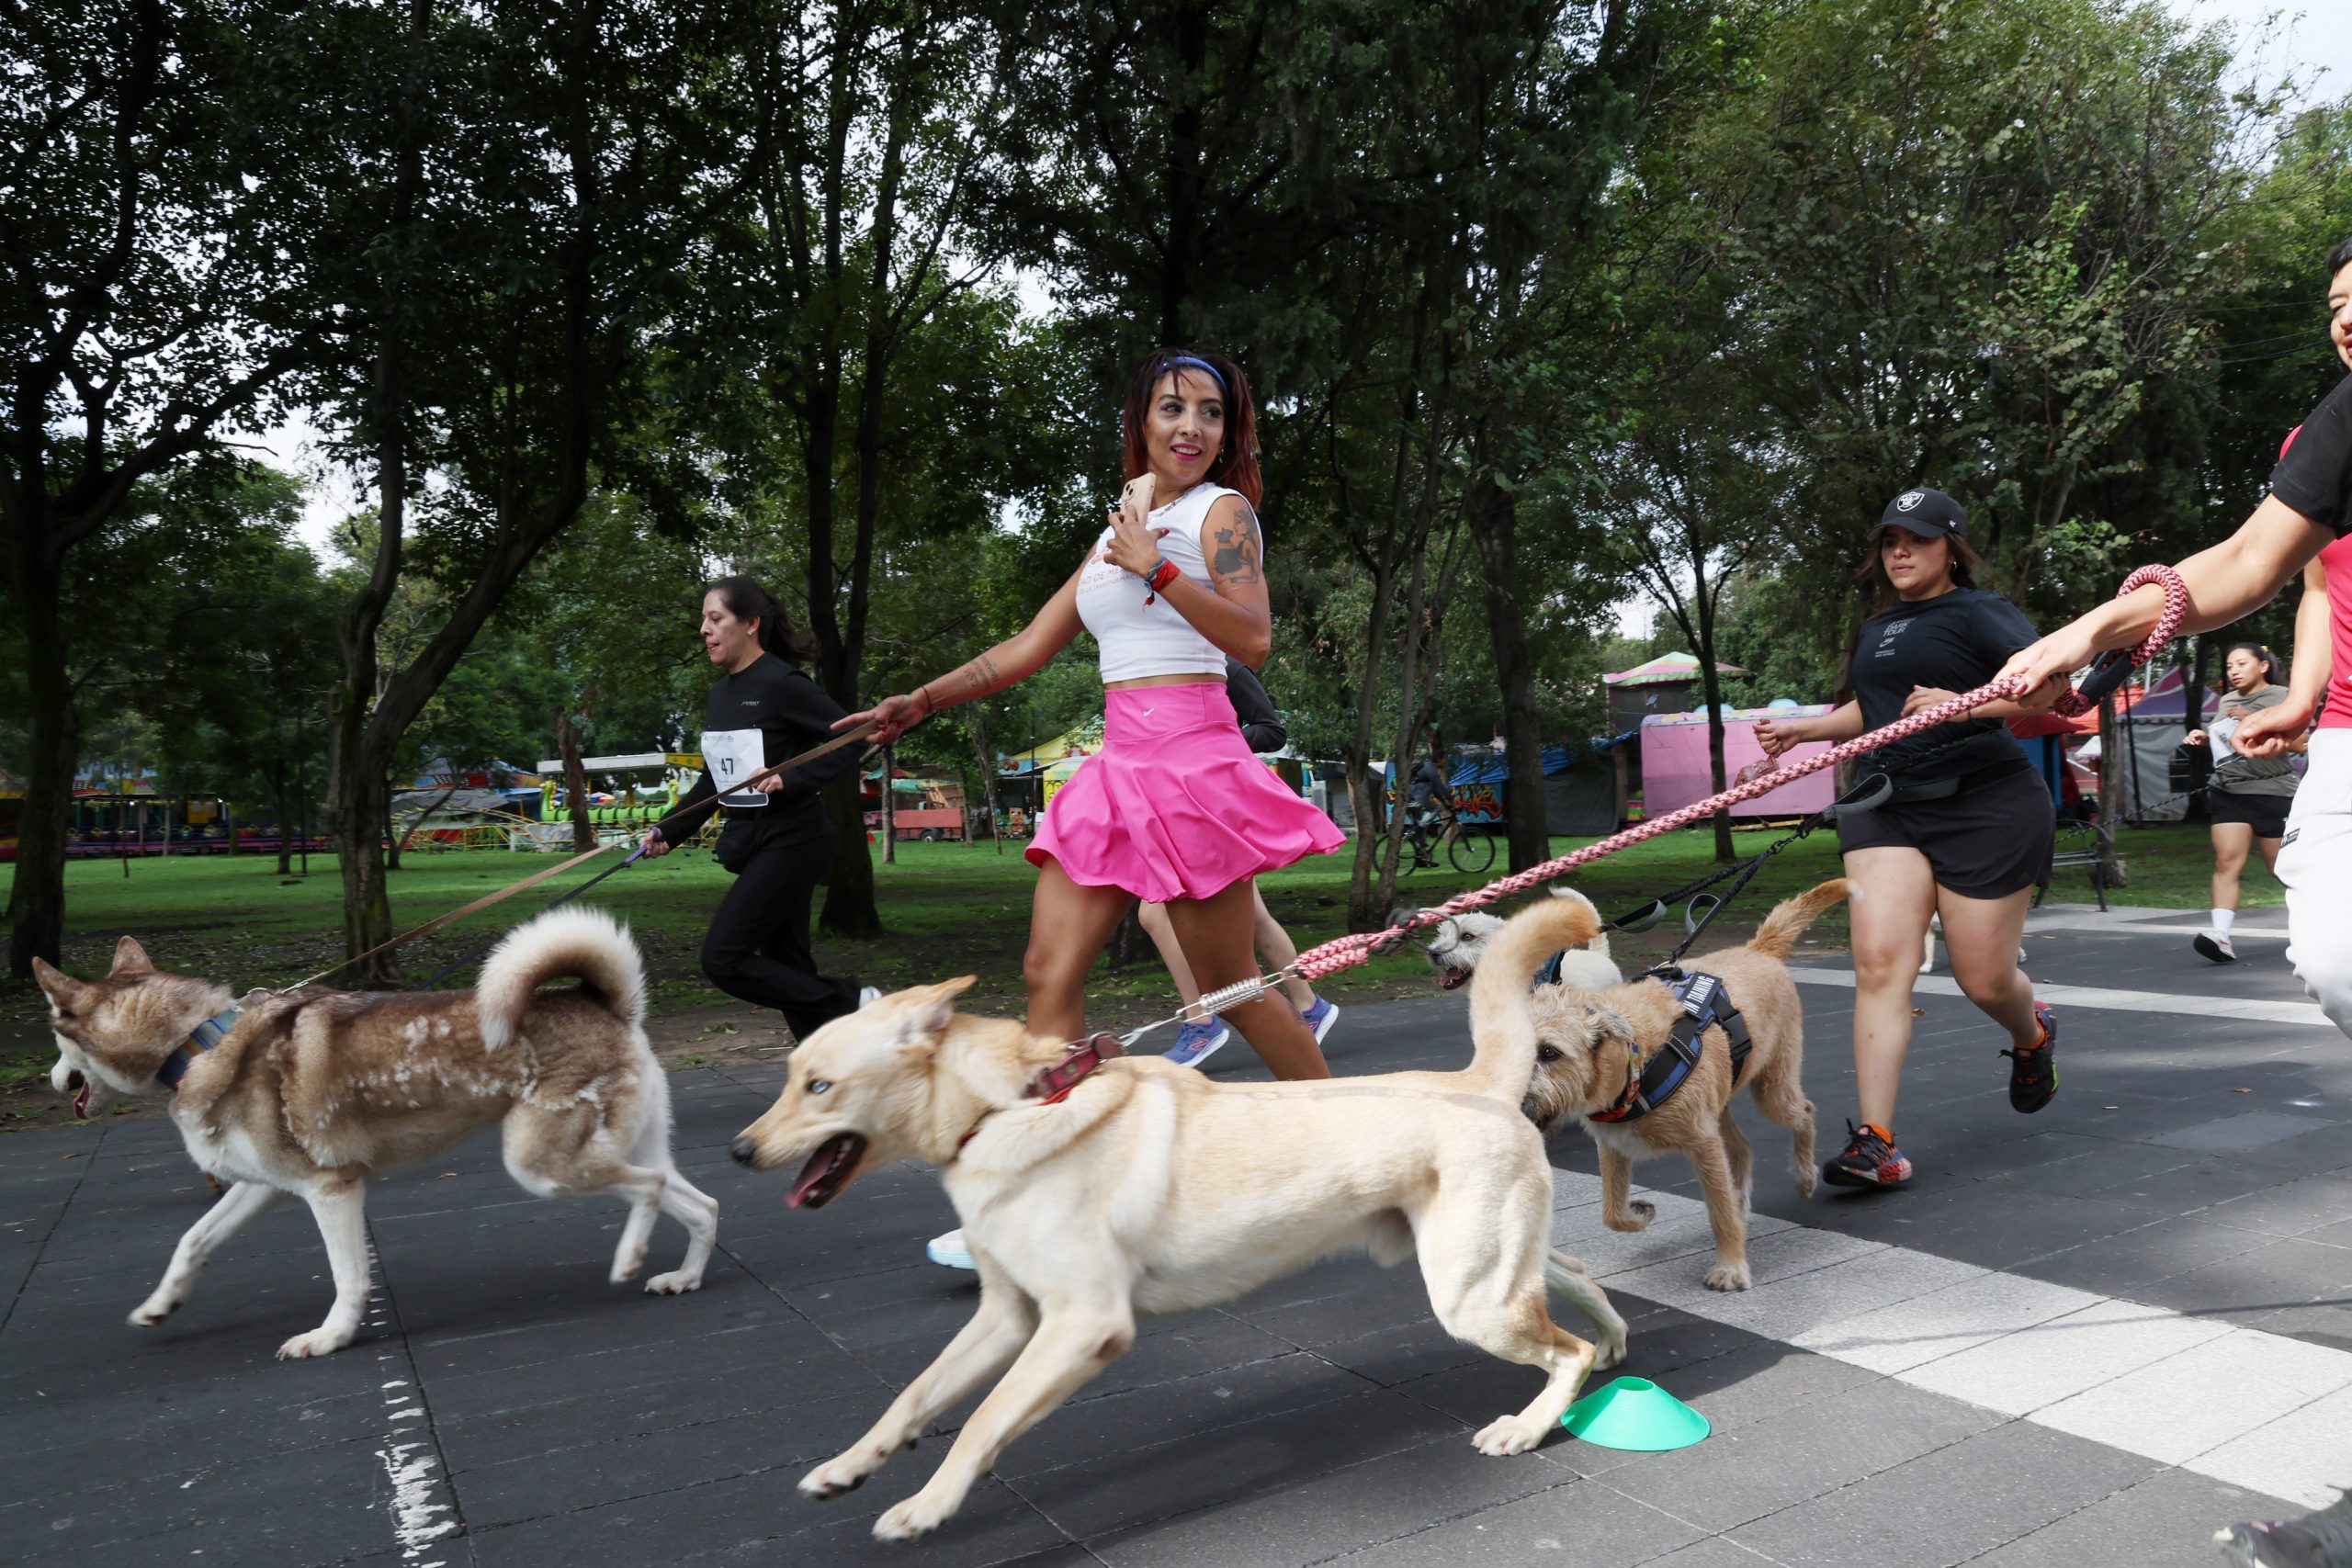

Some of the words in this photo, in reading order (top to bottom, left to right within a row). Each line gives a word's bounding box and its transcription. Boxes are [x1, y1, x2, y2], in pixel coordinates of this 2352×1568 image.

[1883, 627, 1906, 637] TOUR
[721, 758, 734, 775] 47
[1682, 1000, 1701, 1014] IN
